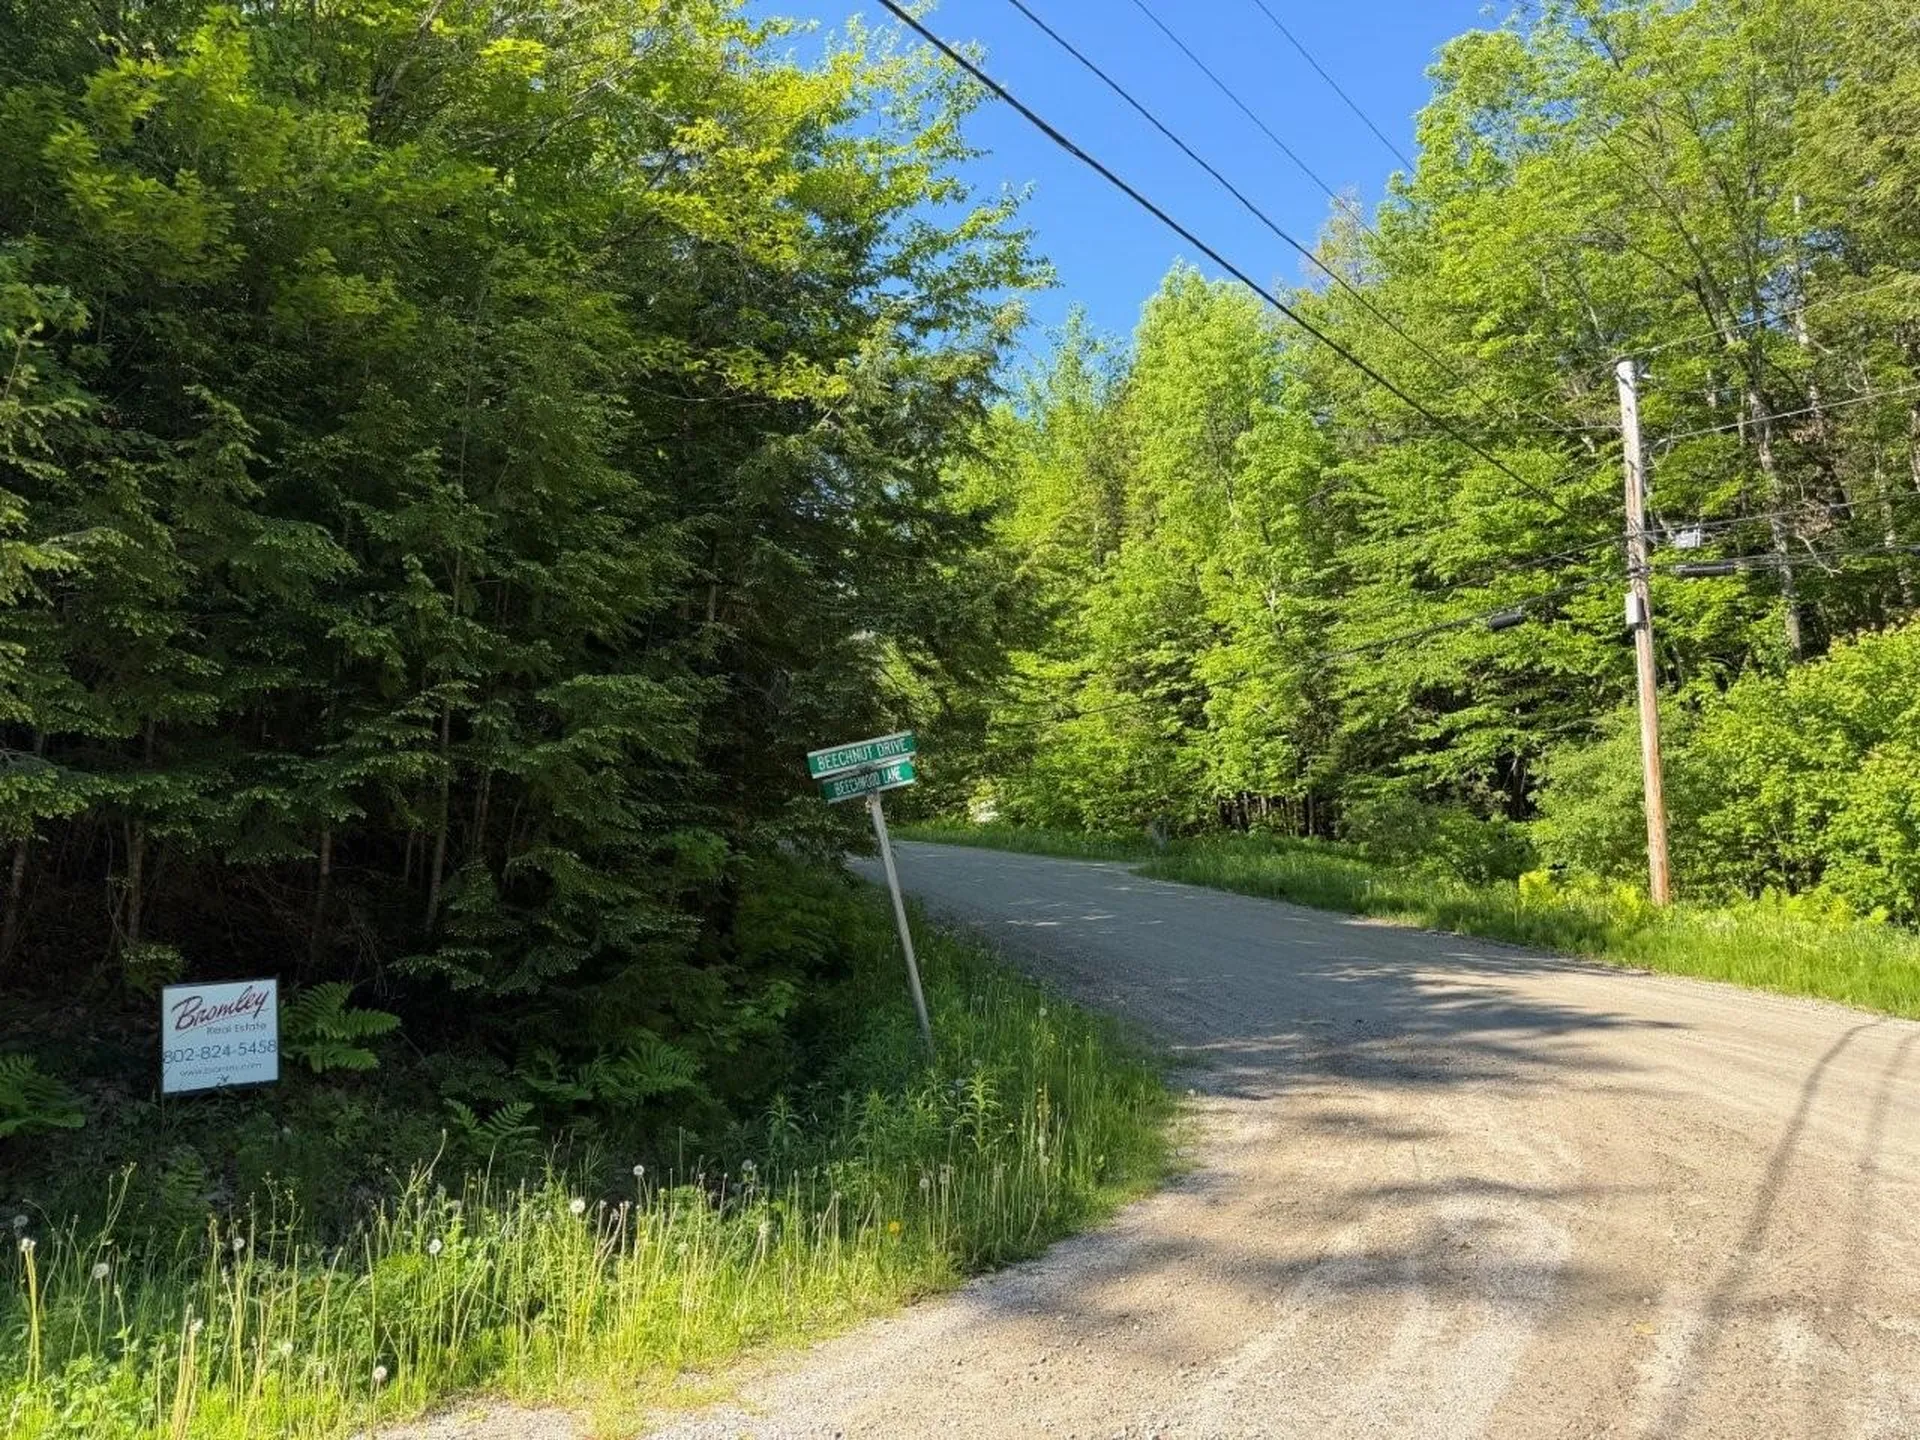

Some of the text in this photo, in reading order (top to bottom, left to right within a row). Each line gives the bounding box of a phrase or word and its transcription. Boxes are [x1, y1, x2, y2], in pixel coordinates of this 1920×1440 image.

[817, 738, 909, 771] BEECHNUT DRIVE
[882, 765, 903, 784] LANE
[171, 984, 270, 1031] Bromley
[206, 1022, 266, 1036] Real Estate
[163, 1040, 277, 1065] 802-824-5458
